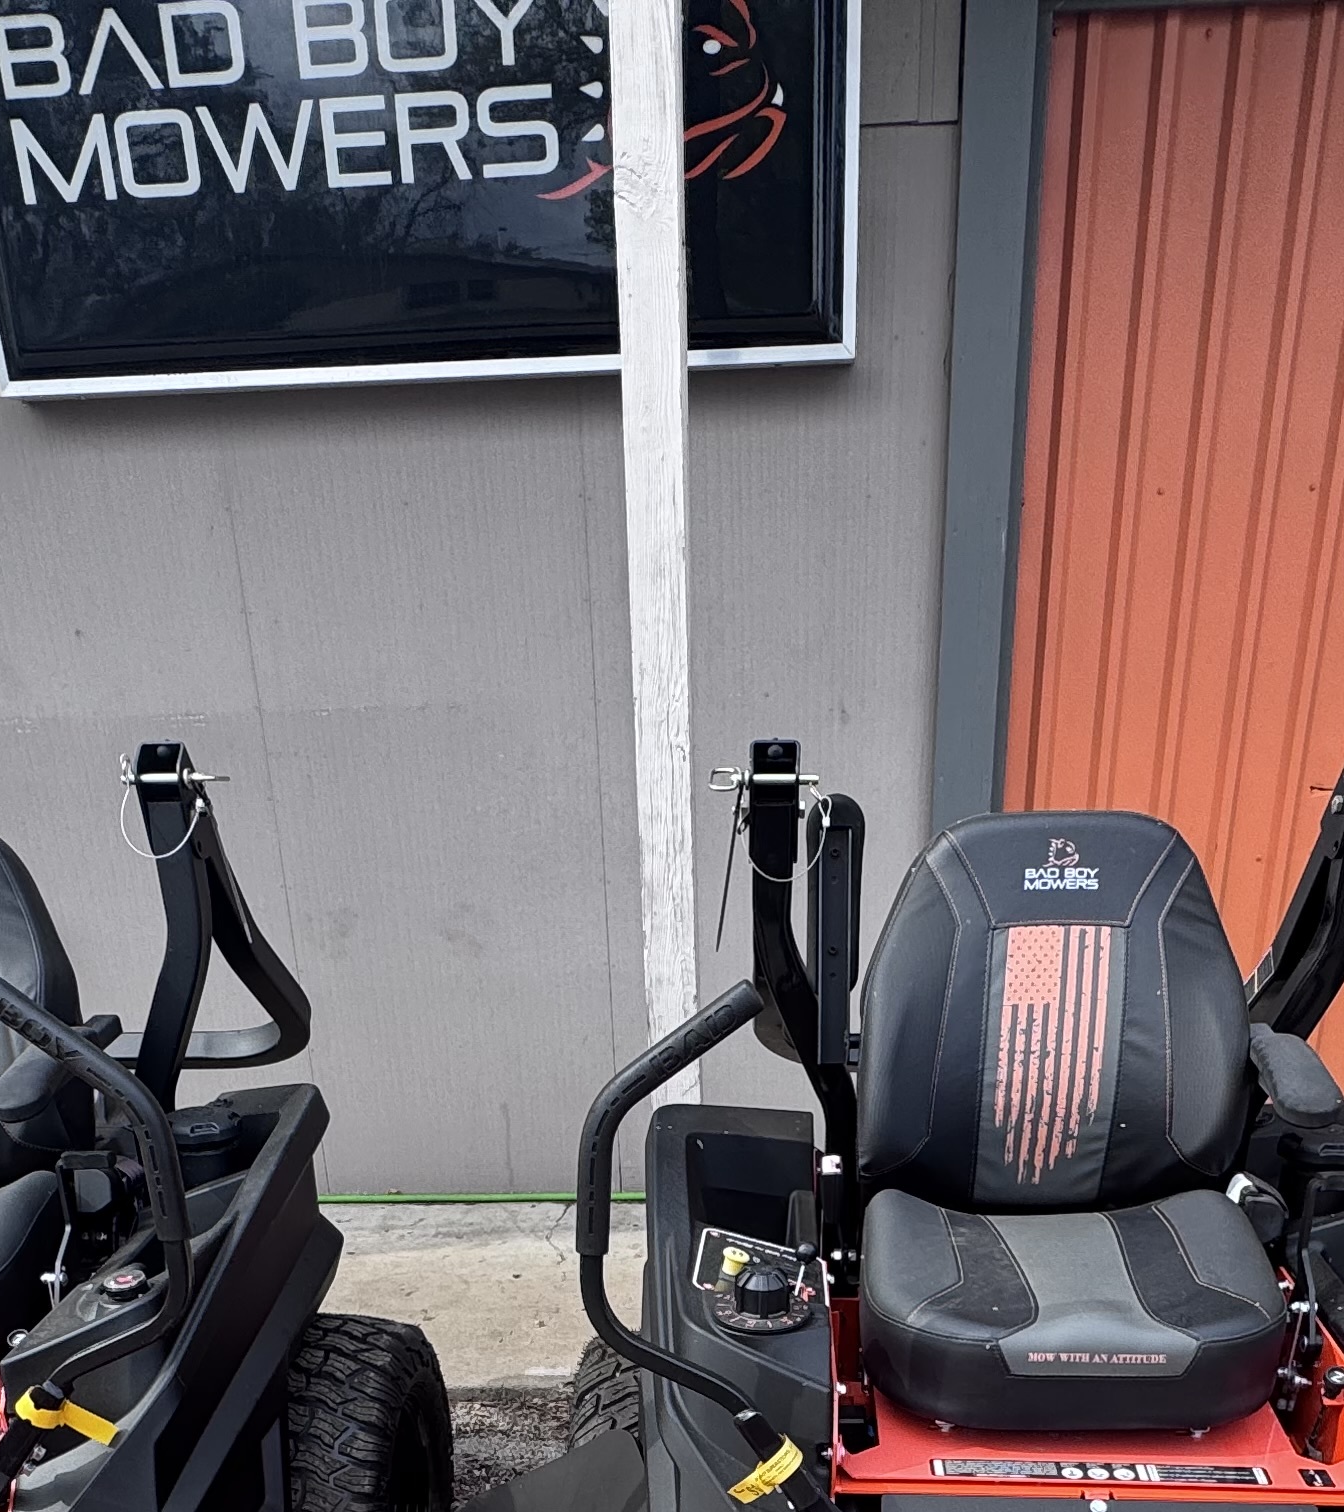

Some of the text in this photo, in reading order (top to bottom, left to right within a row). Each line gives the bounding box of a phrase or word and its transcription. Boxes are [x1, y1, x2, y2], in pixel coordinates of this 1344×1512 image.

[291, 0, 533, 79] BOY
[10, 83, 560, 205] MOWERS
[1023, 879, 1099, 891] MOWERS
[1025, 867, 1100, 879] BAD BOY
[648, 1004, 736, 1079] BAD
[1027, 1352, 1167, 1364] MOW WITH AN ATTITUDE
